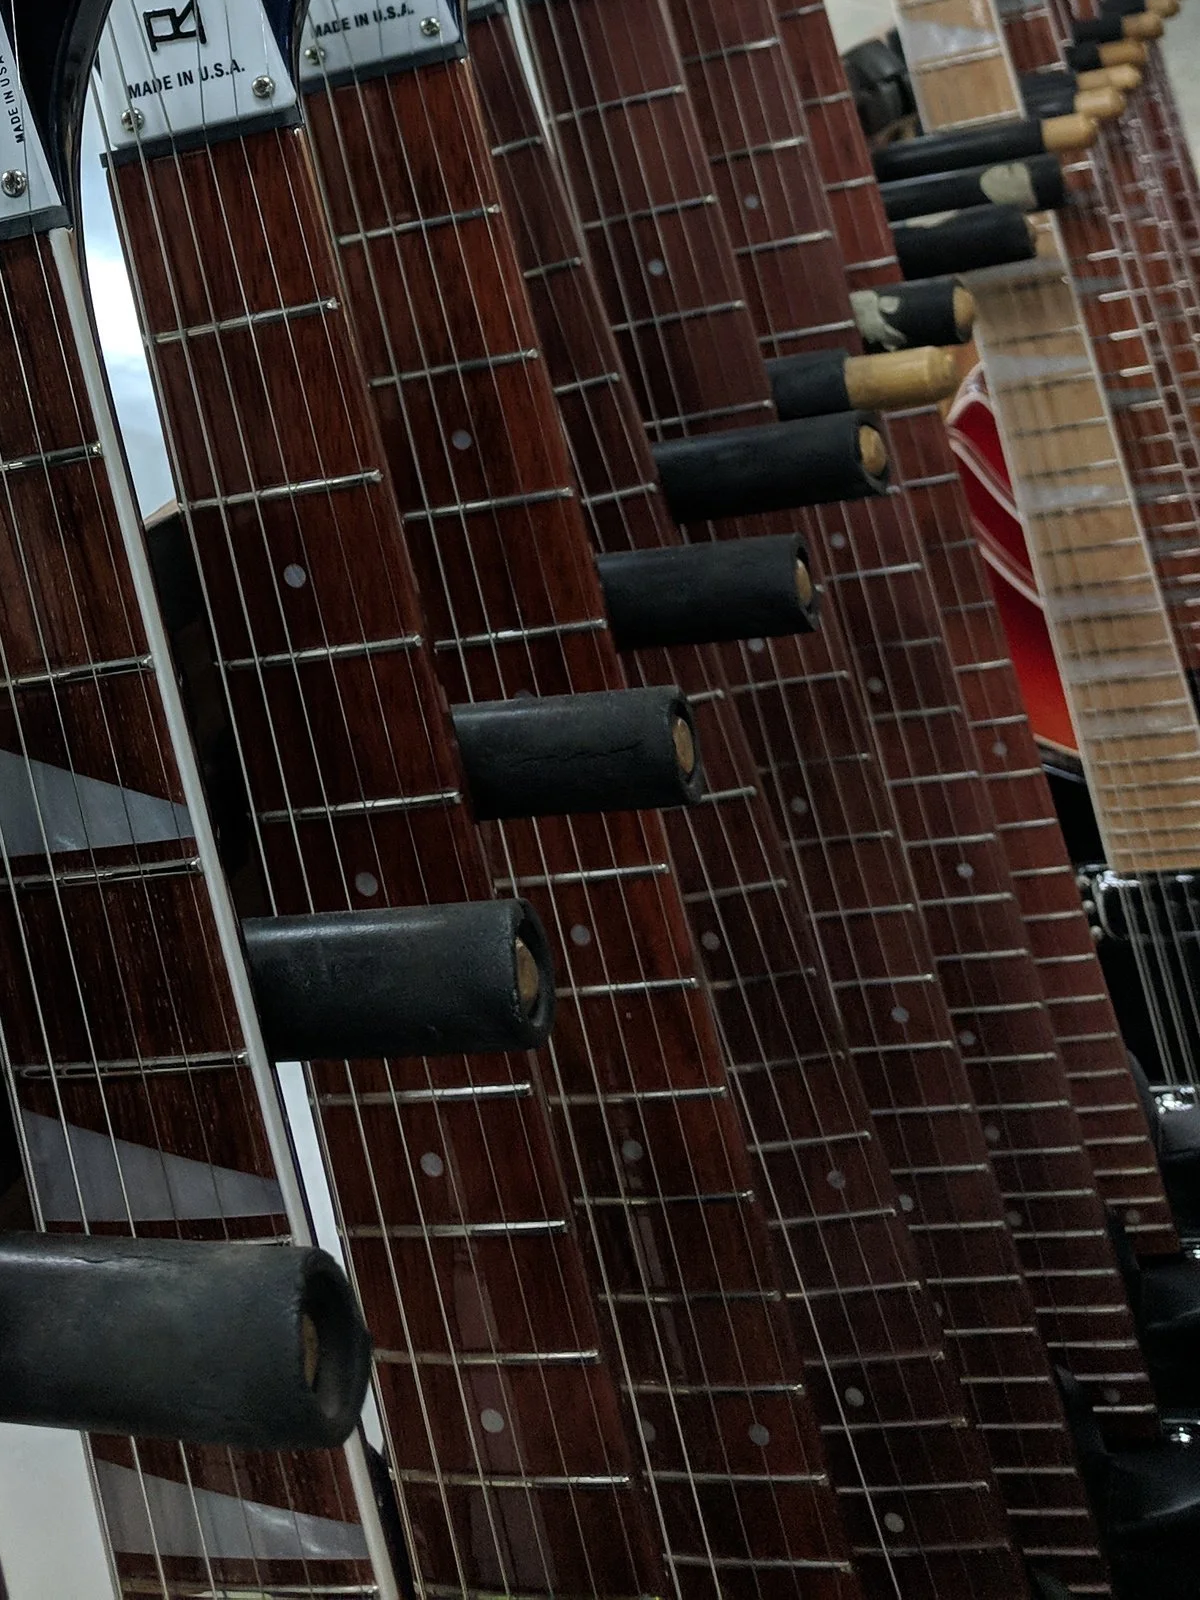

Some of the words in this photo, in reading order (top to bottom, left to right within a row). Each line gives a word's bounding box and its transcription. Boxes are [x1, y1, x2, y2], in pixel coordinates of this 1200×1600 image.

[354, 11, 370, 28] IN
[372, 2, 415, 23] U.S.A.
[128, 74, 173, 99] MADE
[176, 69, 194, 87] IN
[200, 58, 246, 81] U.S.A.
[3, 90, 15, 104] IN
[5, 106, 25, 144] MADE
